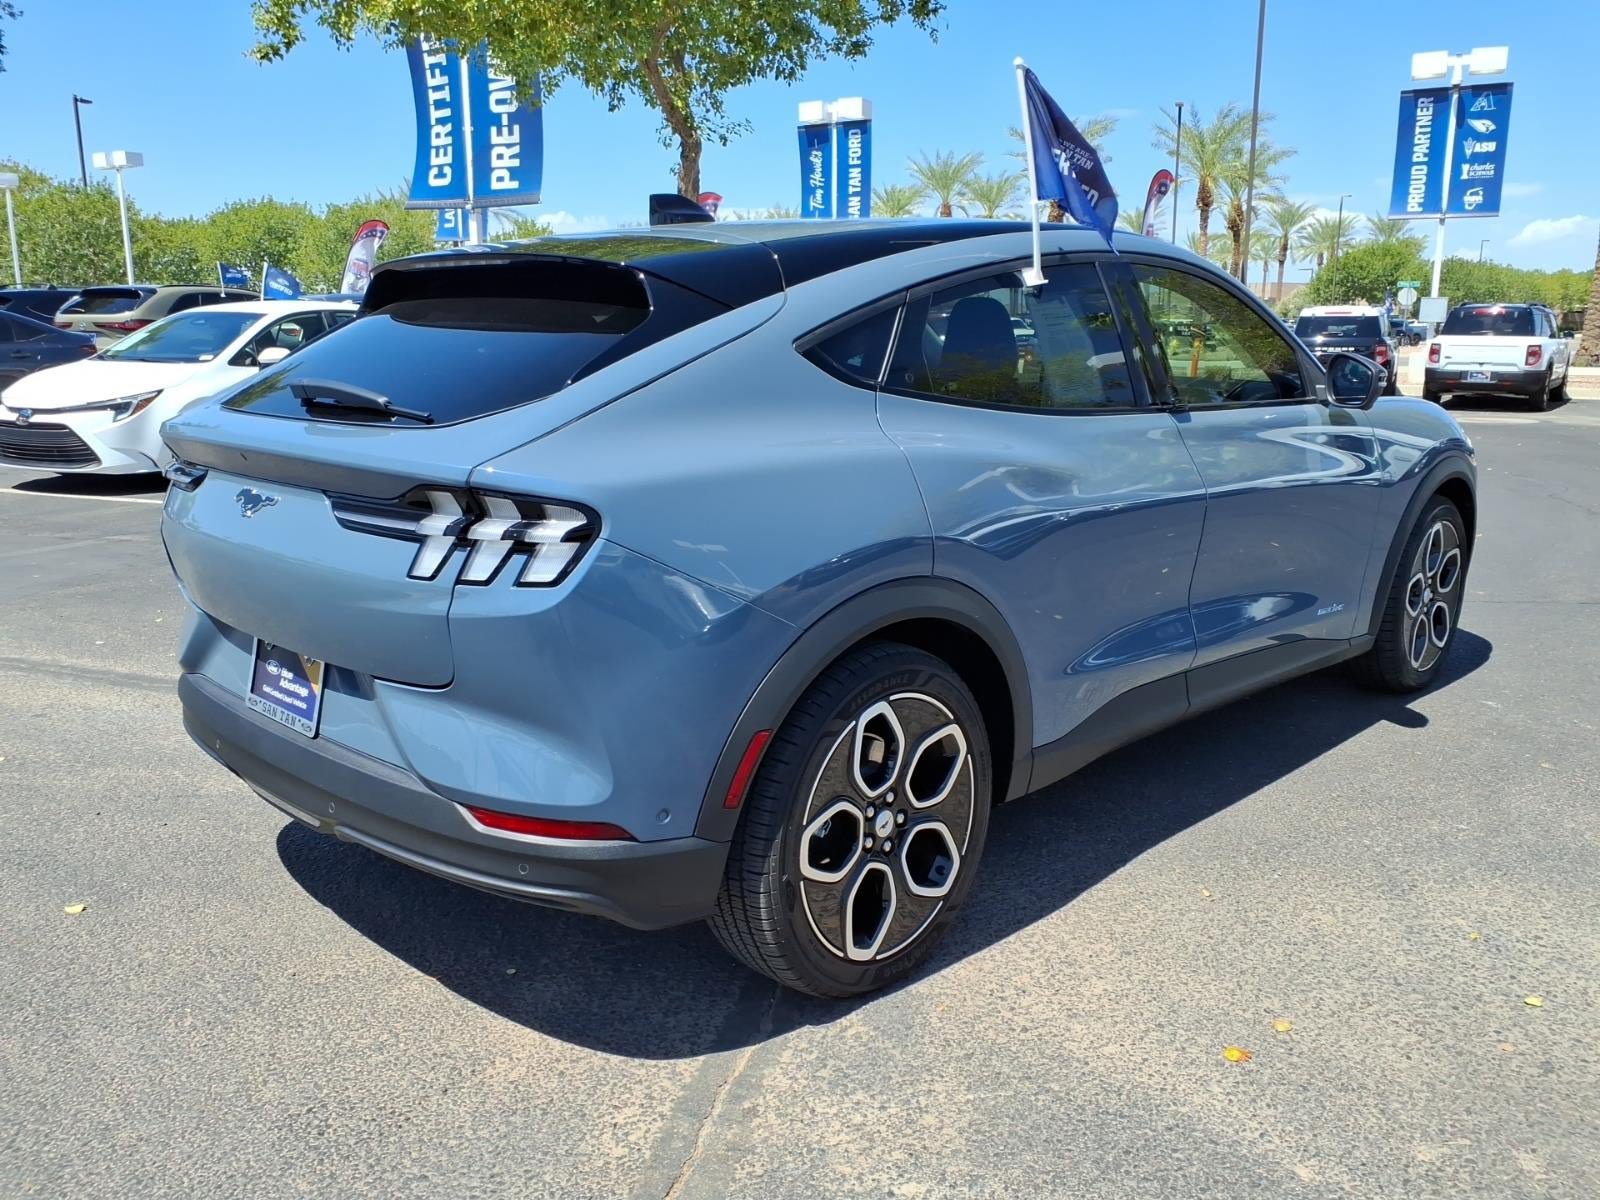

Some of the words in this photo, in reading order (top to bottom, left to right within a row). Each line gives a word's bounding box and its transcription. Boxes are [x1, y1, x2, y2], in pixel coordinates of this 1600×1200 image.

[420, 32, 453, 187] CERTIFIE
[487, 55, 520, 190] PRE-OW
[1412, 97, 1434, 162] PARTNER
[848, 128, 862, 166] FORD
[1072, 153, 1093, 169] TAN
[1074, 147, 1090, 159] ARE
[1473, 141, 1497, 153] ASU
[848, 167, 862, 195] TAN
[1407, 165, 1428, 213] PROUD
[262, 702, 278, 717] SAN
[280, 709, 297, 727] TAN
